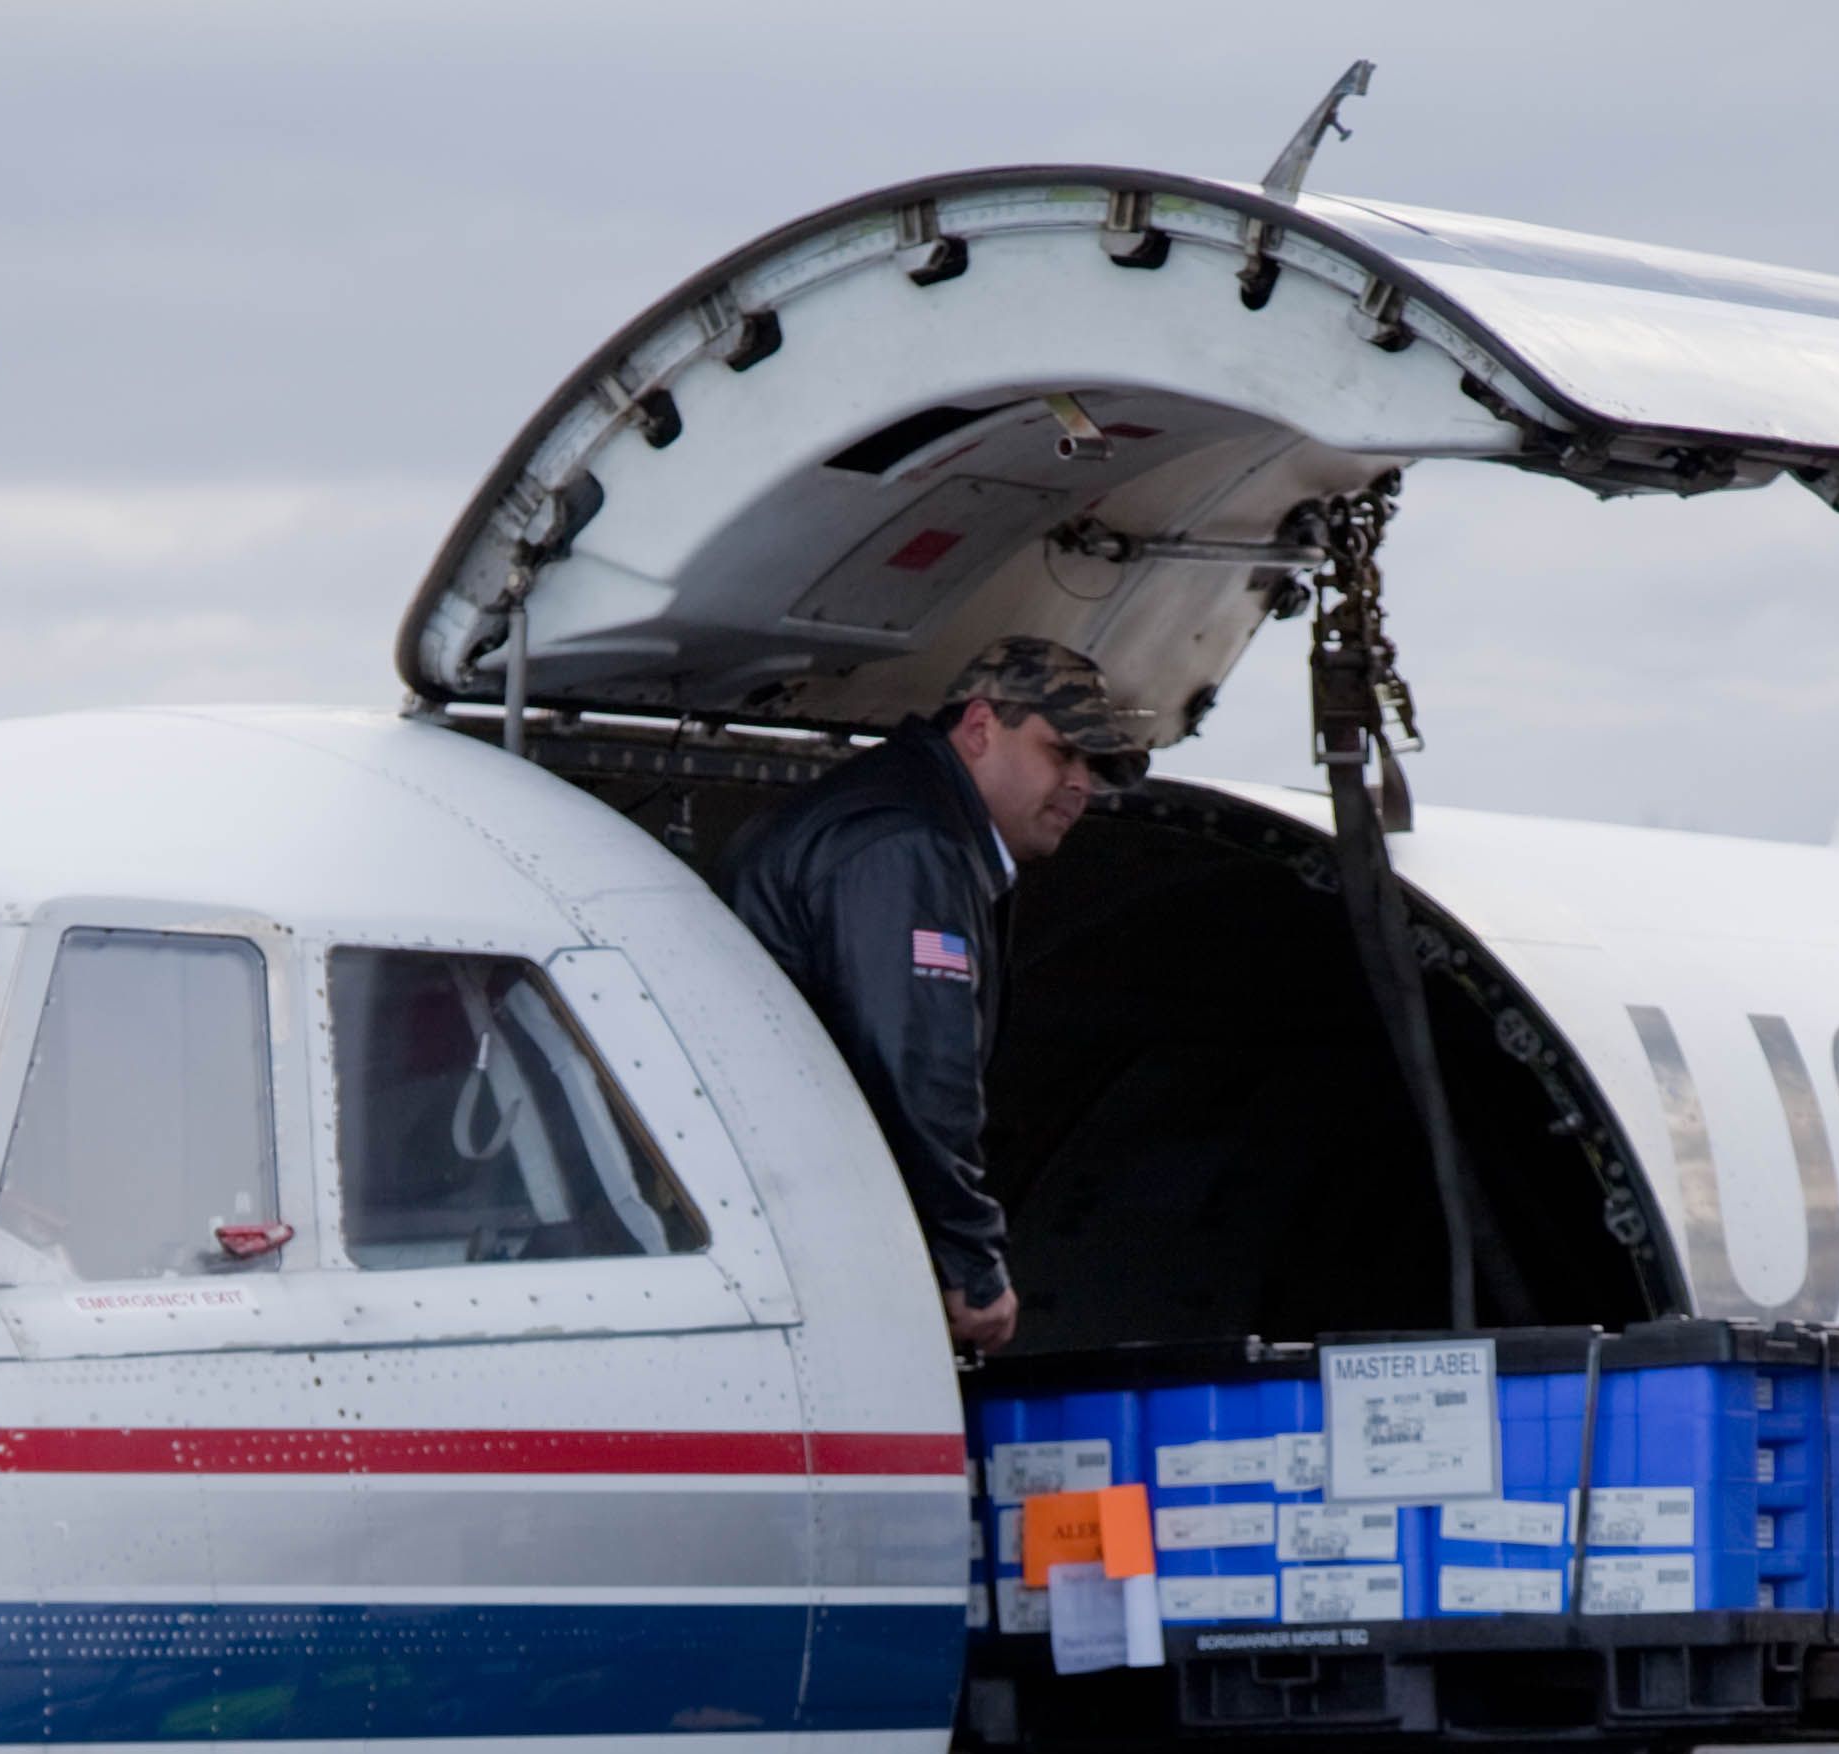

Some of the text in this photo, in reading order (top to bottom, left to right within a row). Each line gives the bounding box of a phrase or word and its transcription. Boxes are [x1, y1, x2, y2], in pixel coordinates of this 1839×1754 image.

[76, 1289, 243, 1310] EMERGENCY EXIT
[1334, 1351, 1483, 1379] MASTER LABEL
